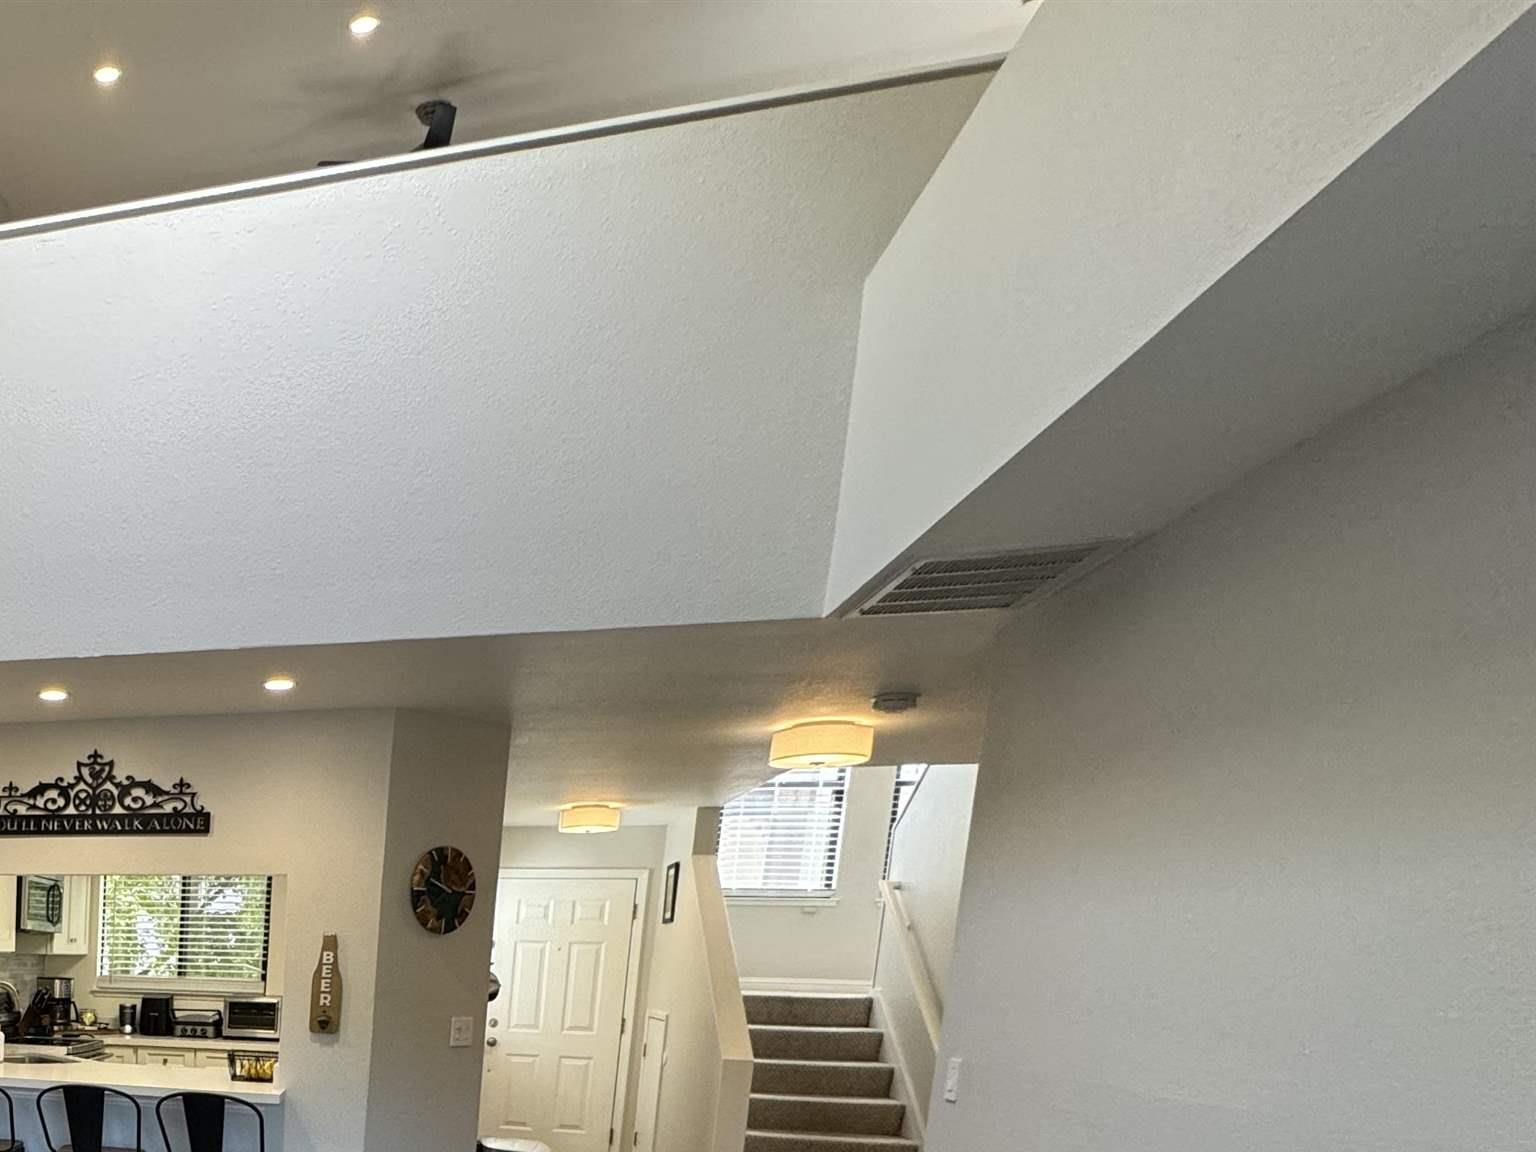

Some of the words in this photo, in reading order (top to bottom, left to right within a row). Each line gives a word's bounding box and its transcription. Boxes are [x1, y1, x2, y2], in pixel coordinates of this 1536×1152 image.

[41, 818, 93, 831] NEVER
[96, 817, 143, 831] WALK
[146, 816, 205, 830] ALONE
[319, 951, 335, 1007] BEER
